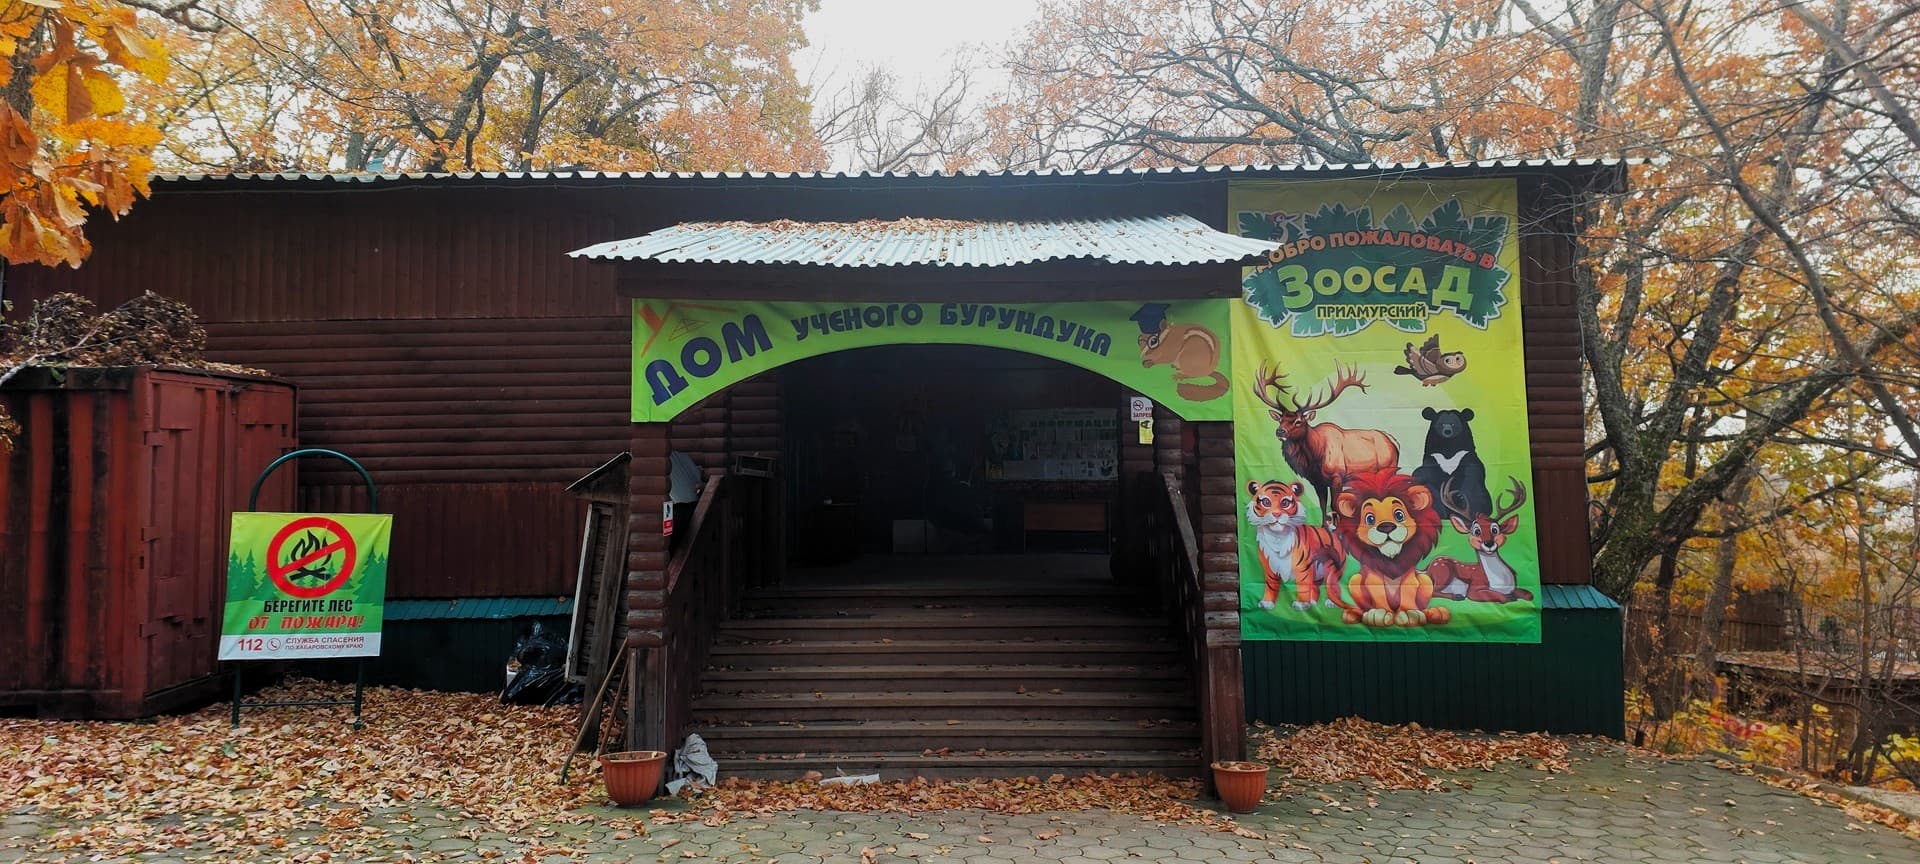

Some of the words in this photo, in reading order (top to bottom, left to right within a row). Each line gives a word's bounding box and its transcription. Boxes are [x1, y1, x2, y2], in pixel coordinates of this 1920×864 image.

[1330, 231, 1475, 262] ПОЖАЛОВАТЬ
[1479, 252, 1497, 270] В
[1277, 264, 1475, 311] ЗООСАД
[1317, 302, 1427, 318] ПРИАМУРСКИЙ
[644, 313, 773, 406] ДОМ
[792, 303, 924, 341] УЧЕНОГО
[940, 303, 1112, 357] БУРУНДУКА
[264, 600, 325, 613] БЕРЕГИТЕ
[328, 600, 353, 612] ЛЕС
[248, 616, 270, 629] ОТ
[280, 615, 365, 629] ПОЖАРА!
[238, 638, 263, 651] 112
